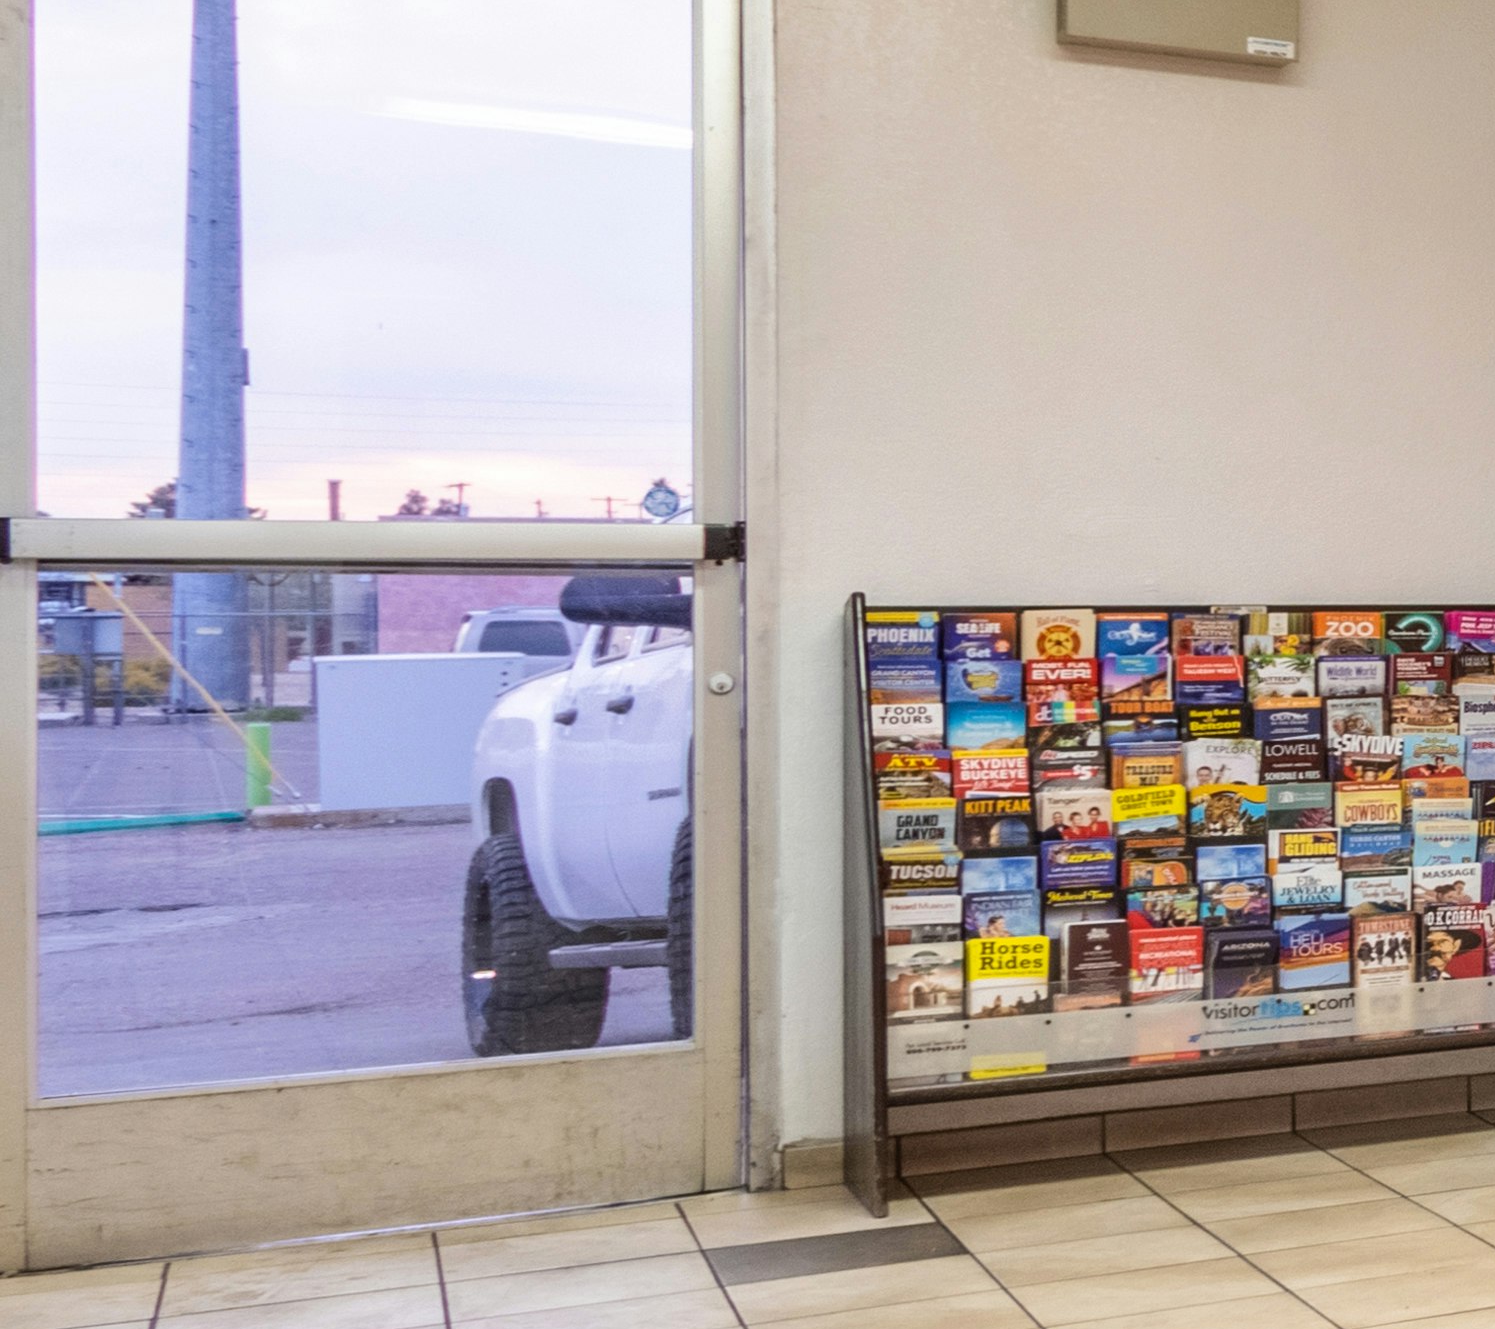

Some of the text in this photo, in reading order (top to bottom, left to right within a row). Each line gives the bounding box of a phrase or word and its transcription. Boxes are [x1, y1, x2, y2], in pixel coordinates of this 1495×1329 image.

[1325, 622, 1374, 636] ZOO
[867, 628, 935, 643] PHOENIX
[966, 647, 991, 659] Get
[1031, 668, 1092, 680] EVER!
[1355, 665, 1378, 677] World
[884, 706, 928, 715] FOOD
[879, 715, 933, 725] TOURS
[1189, 720, 1242, 732] Benson
[1206, 745, 1254, 755] EXPLORE
[1343, 733, 1404, 755] SKYDIVE
[1265, 744, 1319, 757] LOWELL
[888, 757, 938, 768] ATV
[960, 758, 1027, 770] SKYDIVE
[960, 769, 1027, 781] BUCKEYE
[1072, 764, 1093, 780] $5
[1125, 765, 1174, 775] TREASURE
[1116, 788, 1176, 804] GOLDFIELD
[965, 799, 1032, 815] KITT PEAK
[1120, 799, 1174, 811] GHOST TOWN
[1344, 802, 1398, 822] COWBOYS
[896, 814, 939, 828] GRAND
[895, 828, 947, 841] CANYON
[1285, 833, 1314, 844] HANG
[1285, 842, 1337, 856] GLIDING
[890, 865, 959, 880] TUCSON
[1422, 867, 1477, 879] MASSAGE
[1281, 884, 1337, 897] JEWELRY
[1286, 893, 1332, 904] & LOAN
[891, 902, 956, 911] Heard Museum
[1222, 941, 1271, 951] ARIZONA
[1290, 933, 1325, 947] HELI
[981, 941, 1044, 956] Horse
[1291, 942, 1343, 957] TOURS
[980, 956, 1044, 972] Rides
